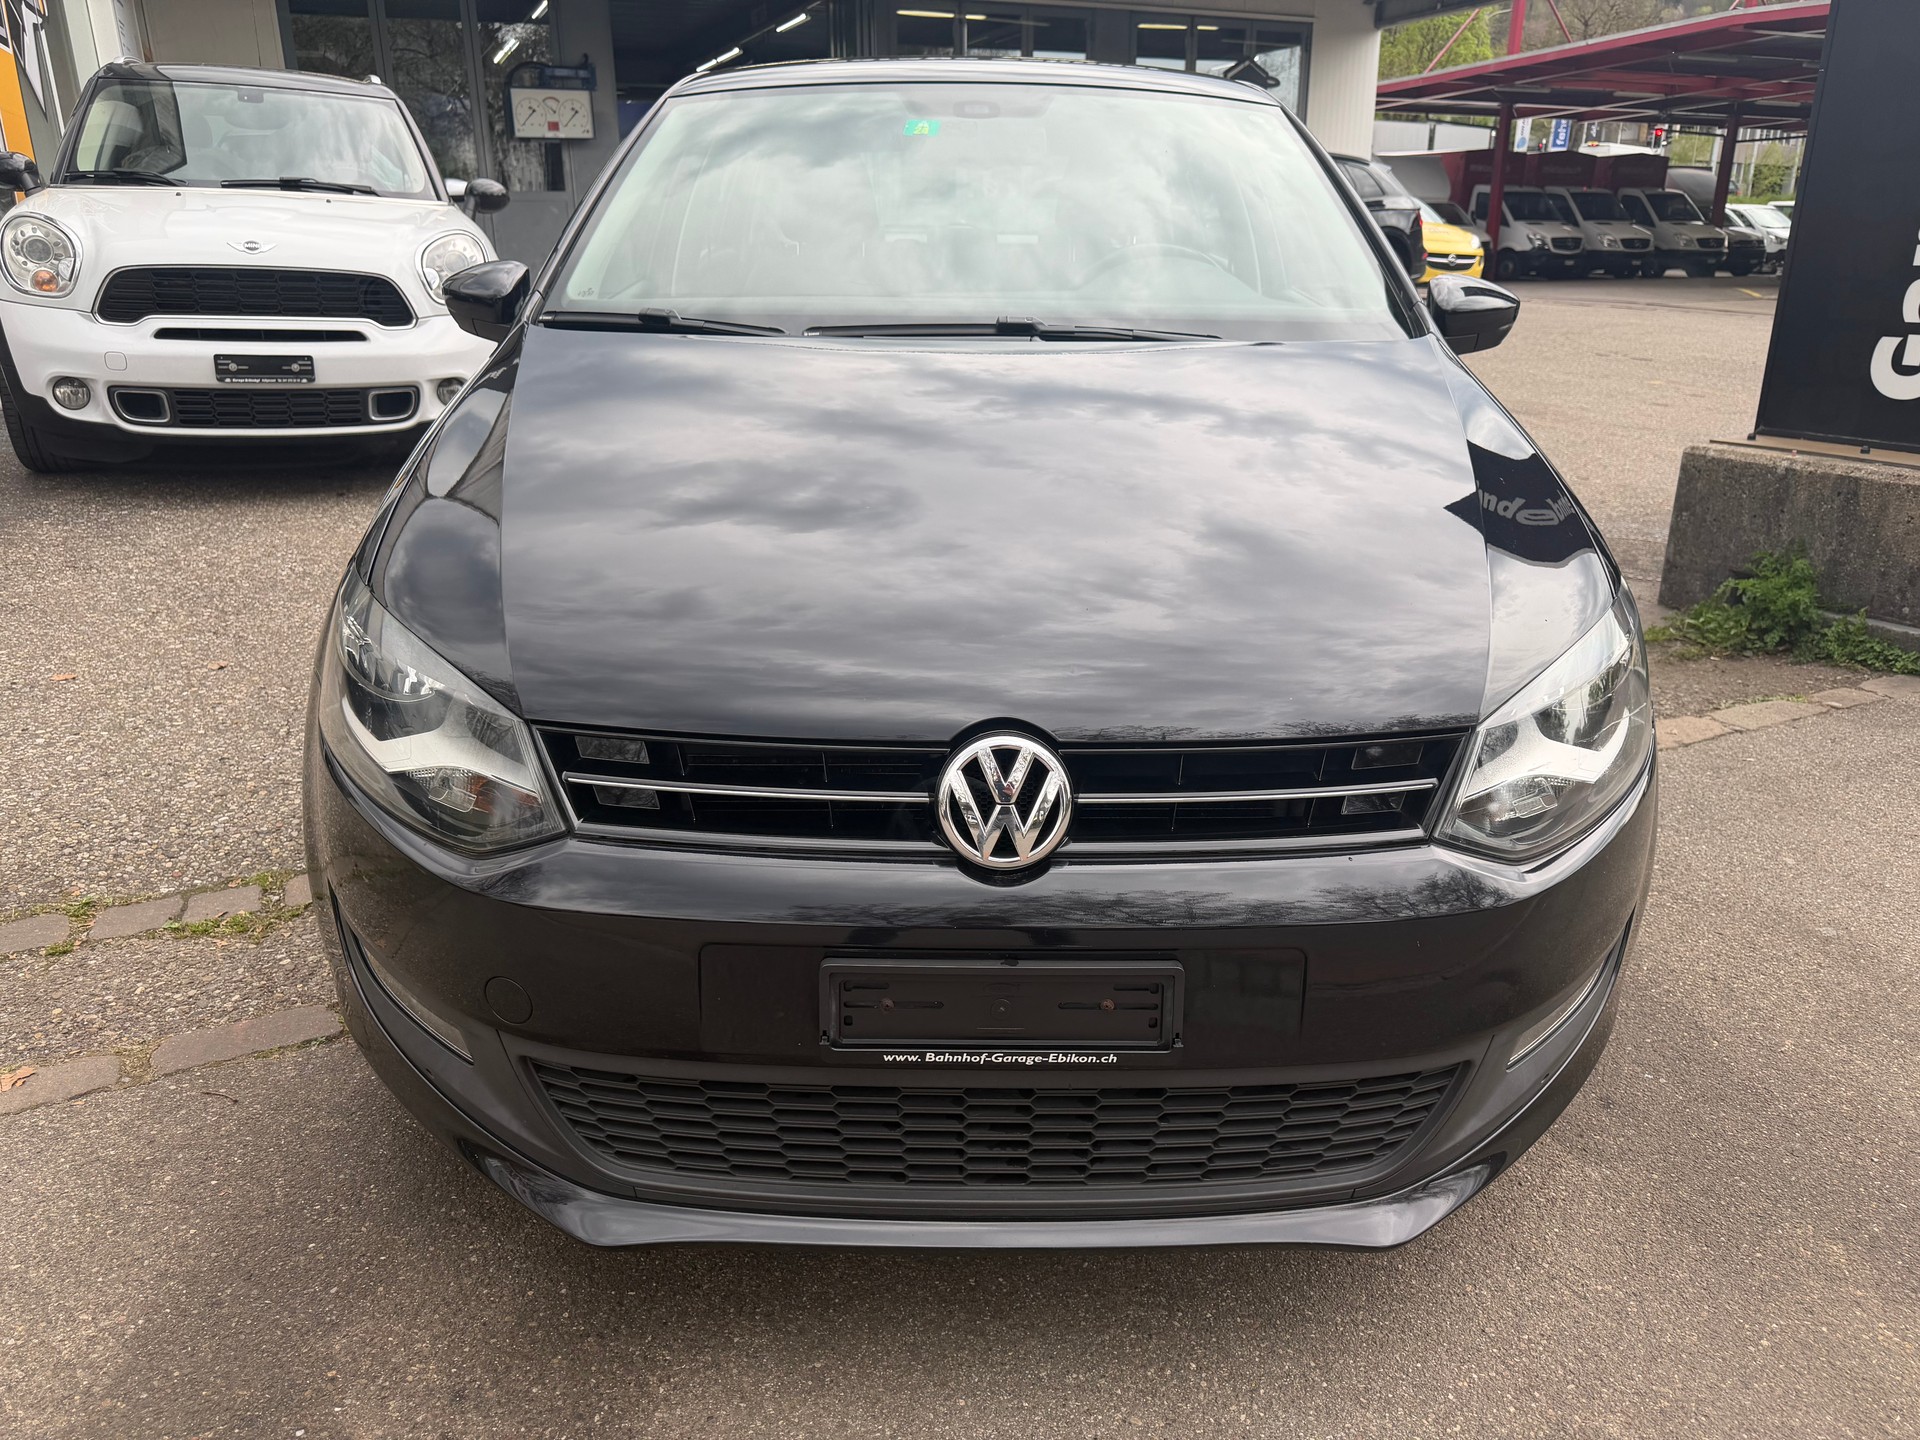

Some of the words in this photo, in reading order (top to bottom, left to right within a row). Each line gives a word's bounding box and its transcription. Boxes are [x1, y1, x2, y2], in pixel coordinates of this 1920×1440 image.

[942, 740, 1066, 864] VW
[882, 1054, 922, 1062] www.
[925, 1052, 1118, 1066] Bahnhof-Garage-Ebikon.ch
